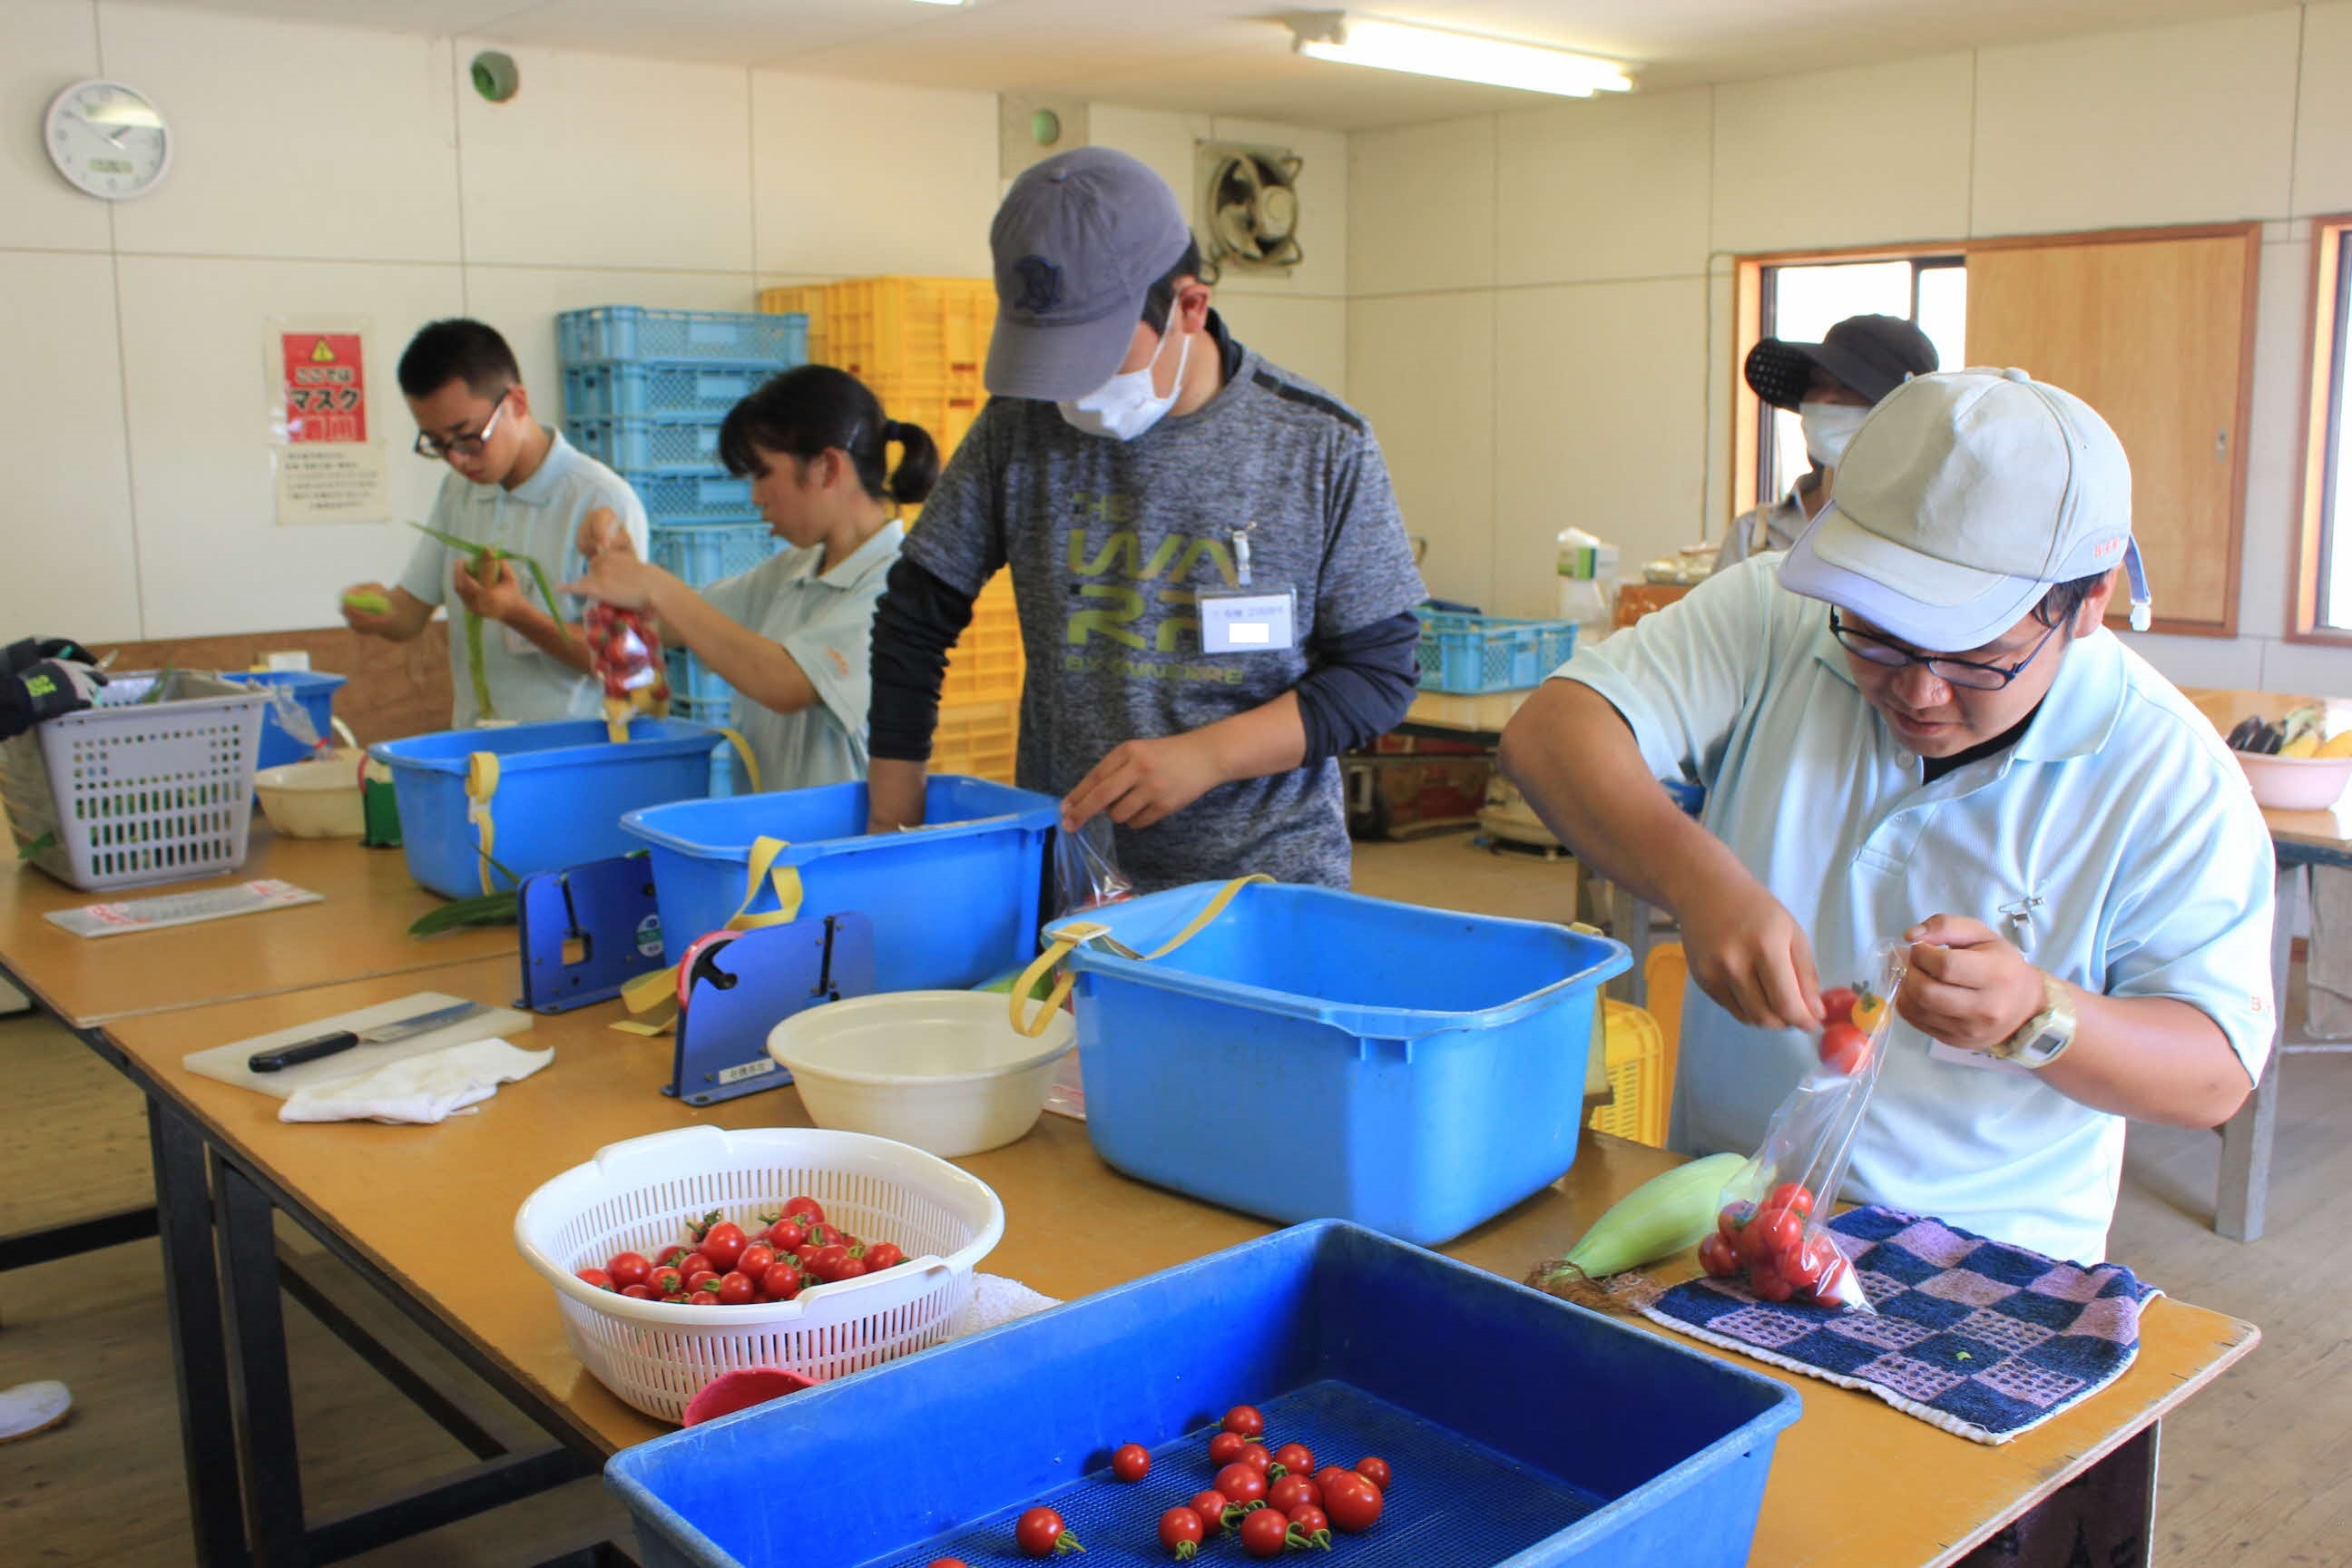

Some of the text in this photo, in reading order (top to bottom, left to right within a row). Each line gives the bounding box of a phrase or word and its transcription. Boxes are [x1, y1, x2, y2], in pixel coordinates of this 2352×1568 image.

[296, 367, 353, 383] ここでは
[289, 388, 359, 410] マスク
